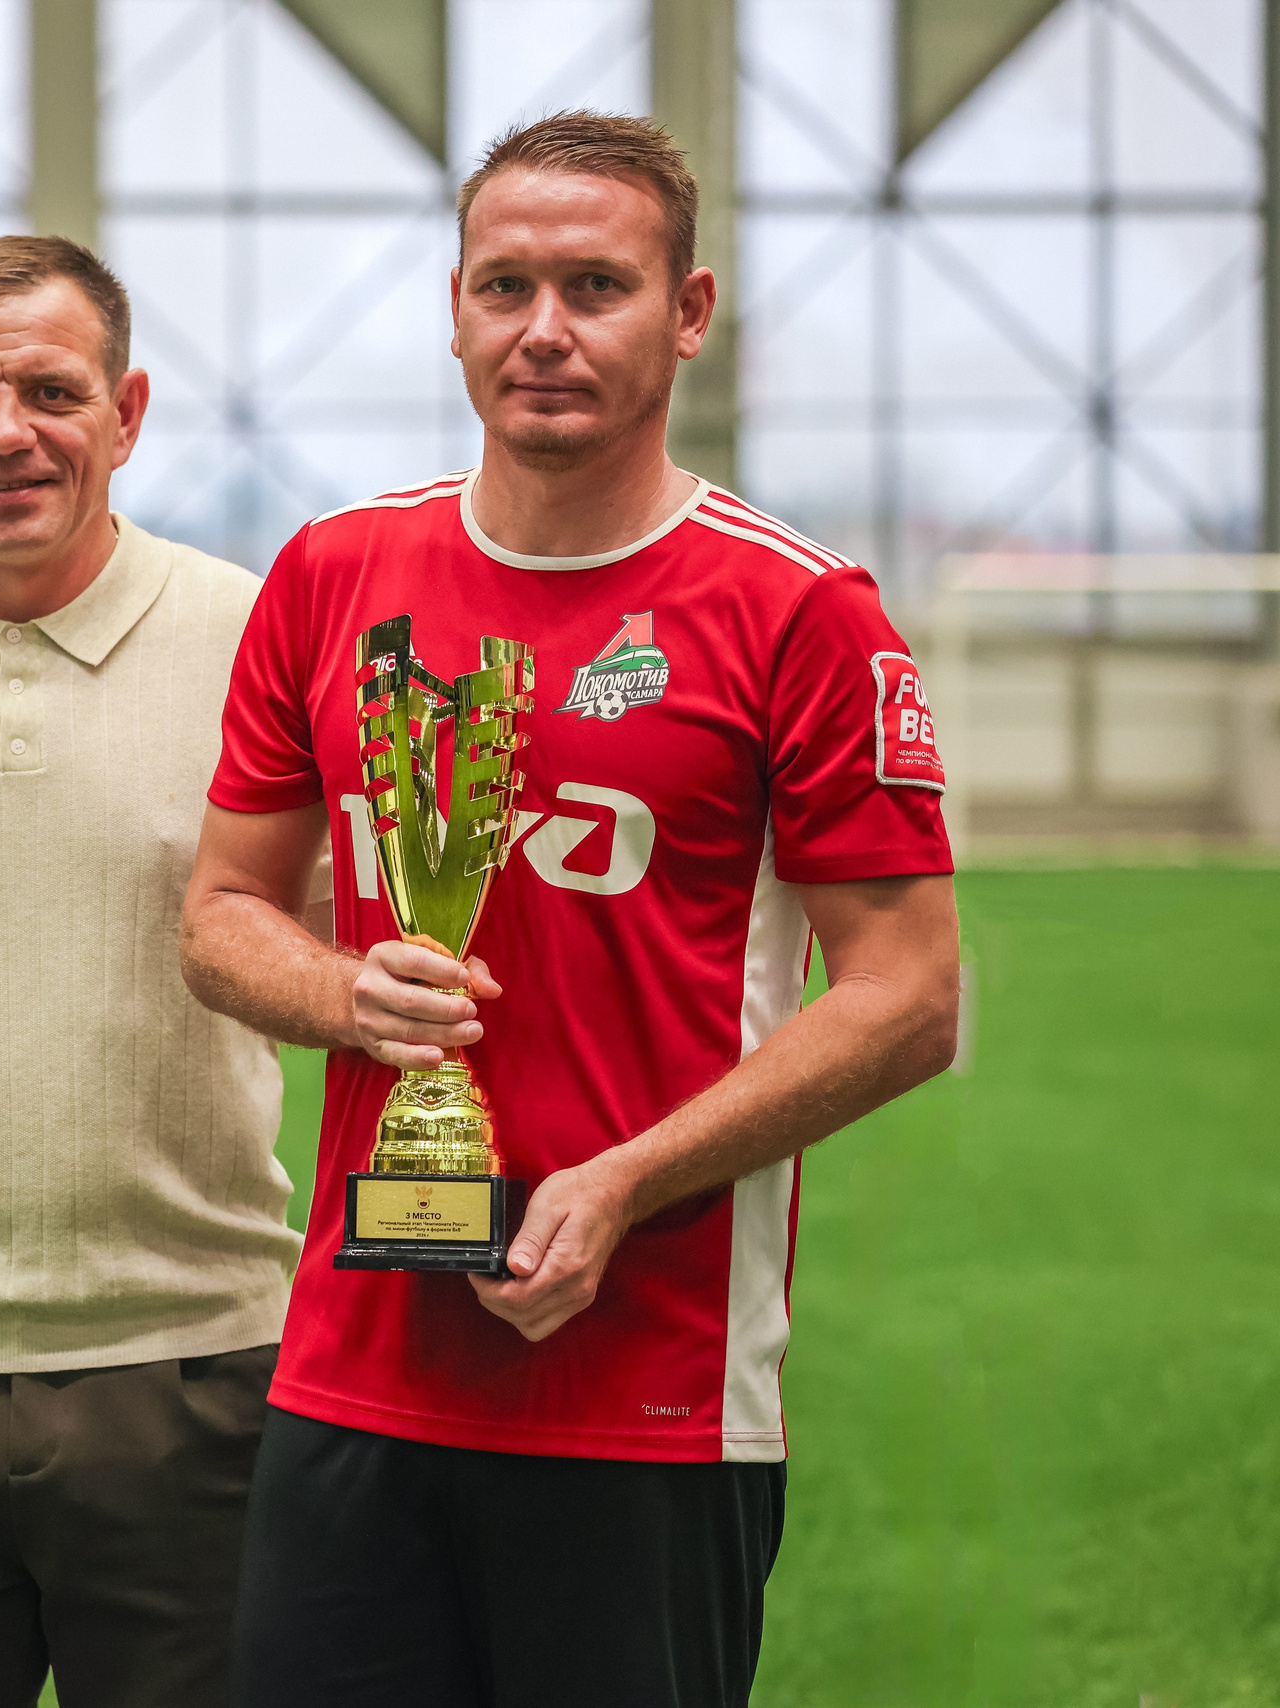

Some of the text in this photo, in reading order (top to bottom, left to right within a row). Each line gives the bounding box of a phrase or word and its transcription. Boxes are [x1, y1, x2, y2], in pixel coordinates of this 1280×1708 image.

[566, 665, 669, 706] ЛОКОМОТИВ
[631, 688, 663, 699] САМАРА
[405, 1212, 442, 1220] 3 МЕСТО
[644, 1404, 690, 1416] CLIMALITE
